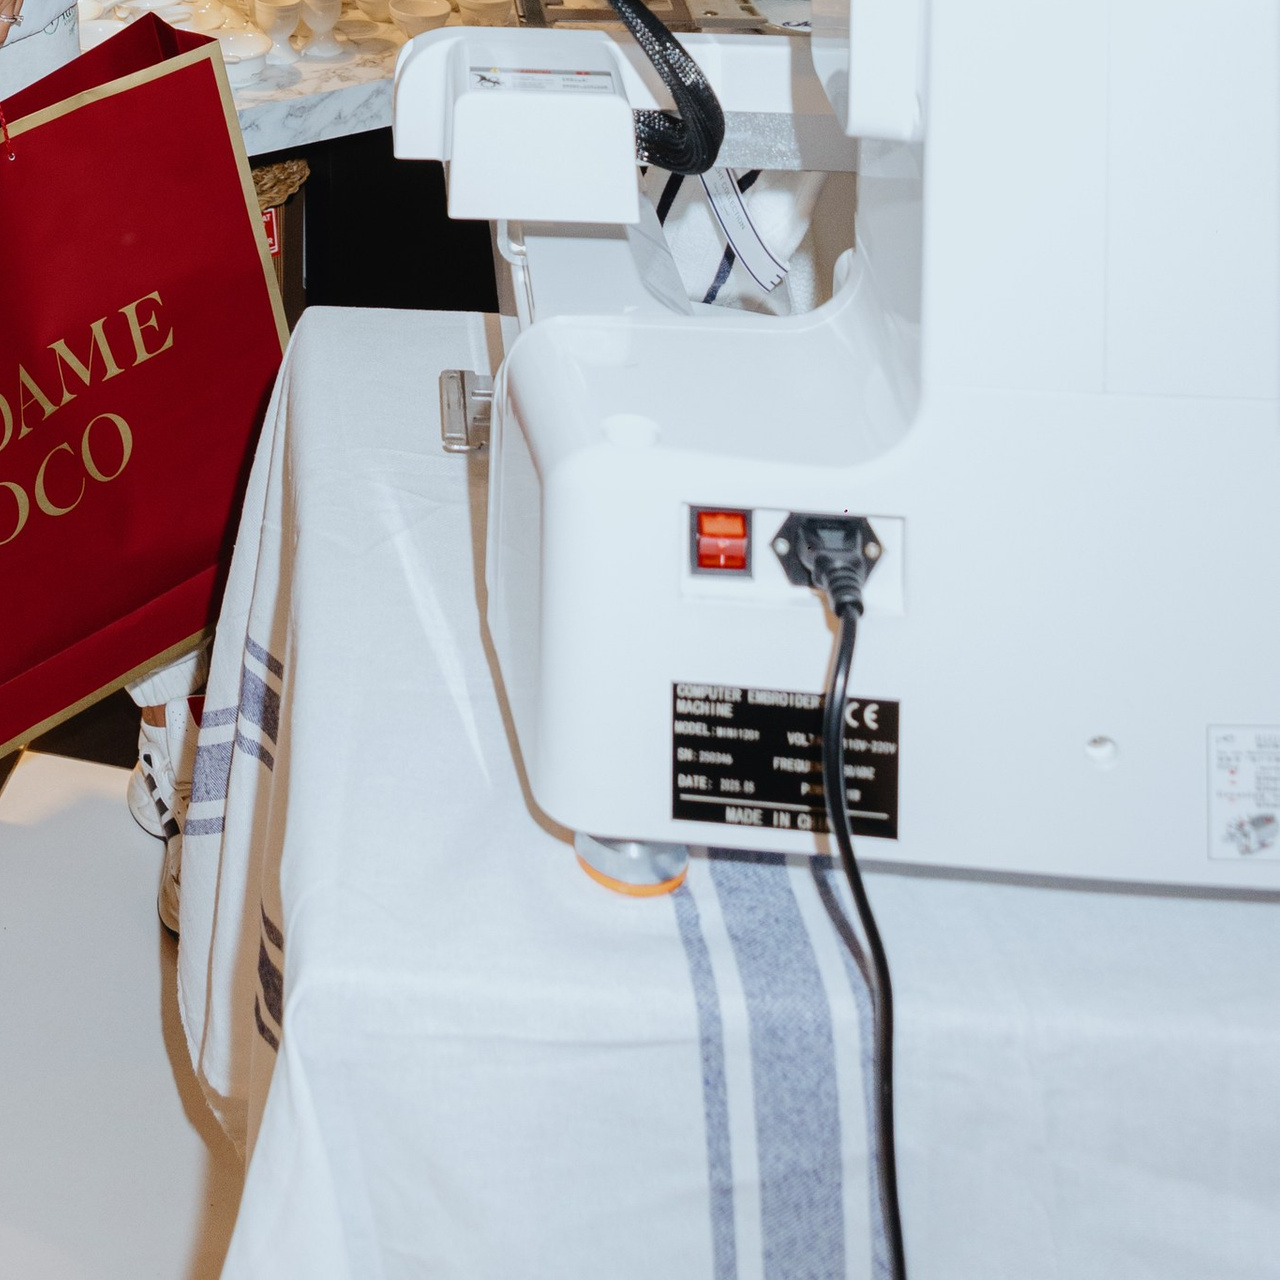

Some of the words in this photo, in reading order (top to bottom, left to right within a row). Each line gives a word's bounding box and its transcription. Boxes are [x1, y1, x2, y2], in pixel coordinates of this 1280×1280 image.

[676, 684, 742, 703] COMPUTER
[676, 698, 735, 719] MACHINE
[725, 806, 764, 827] MADE
[772, 811, 791, 830] IN
